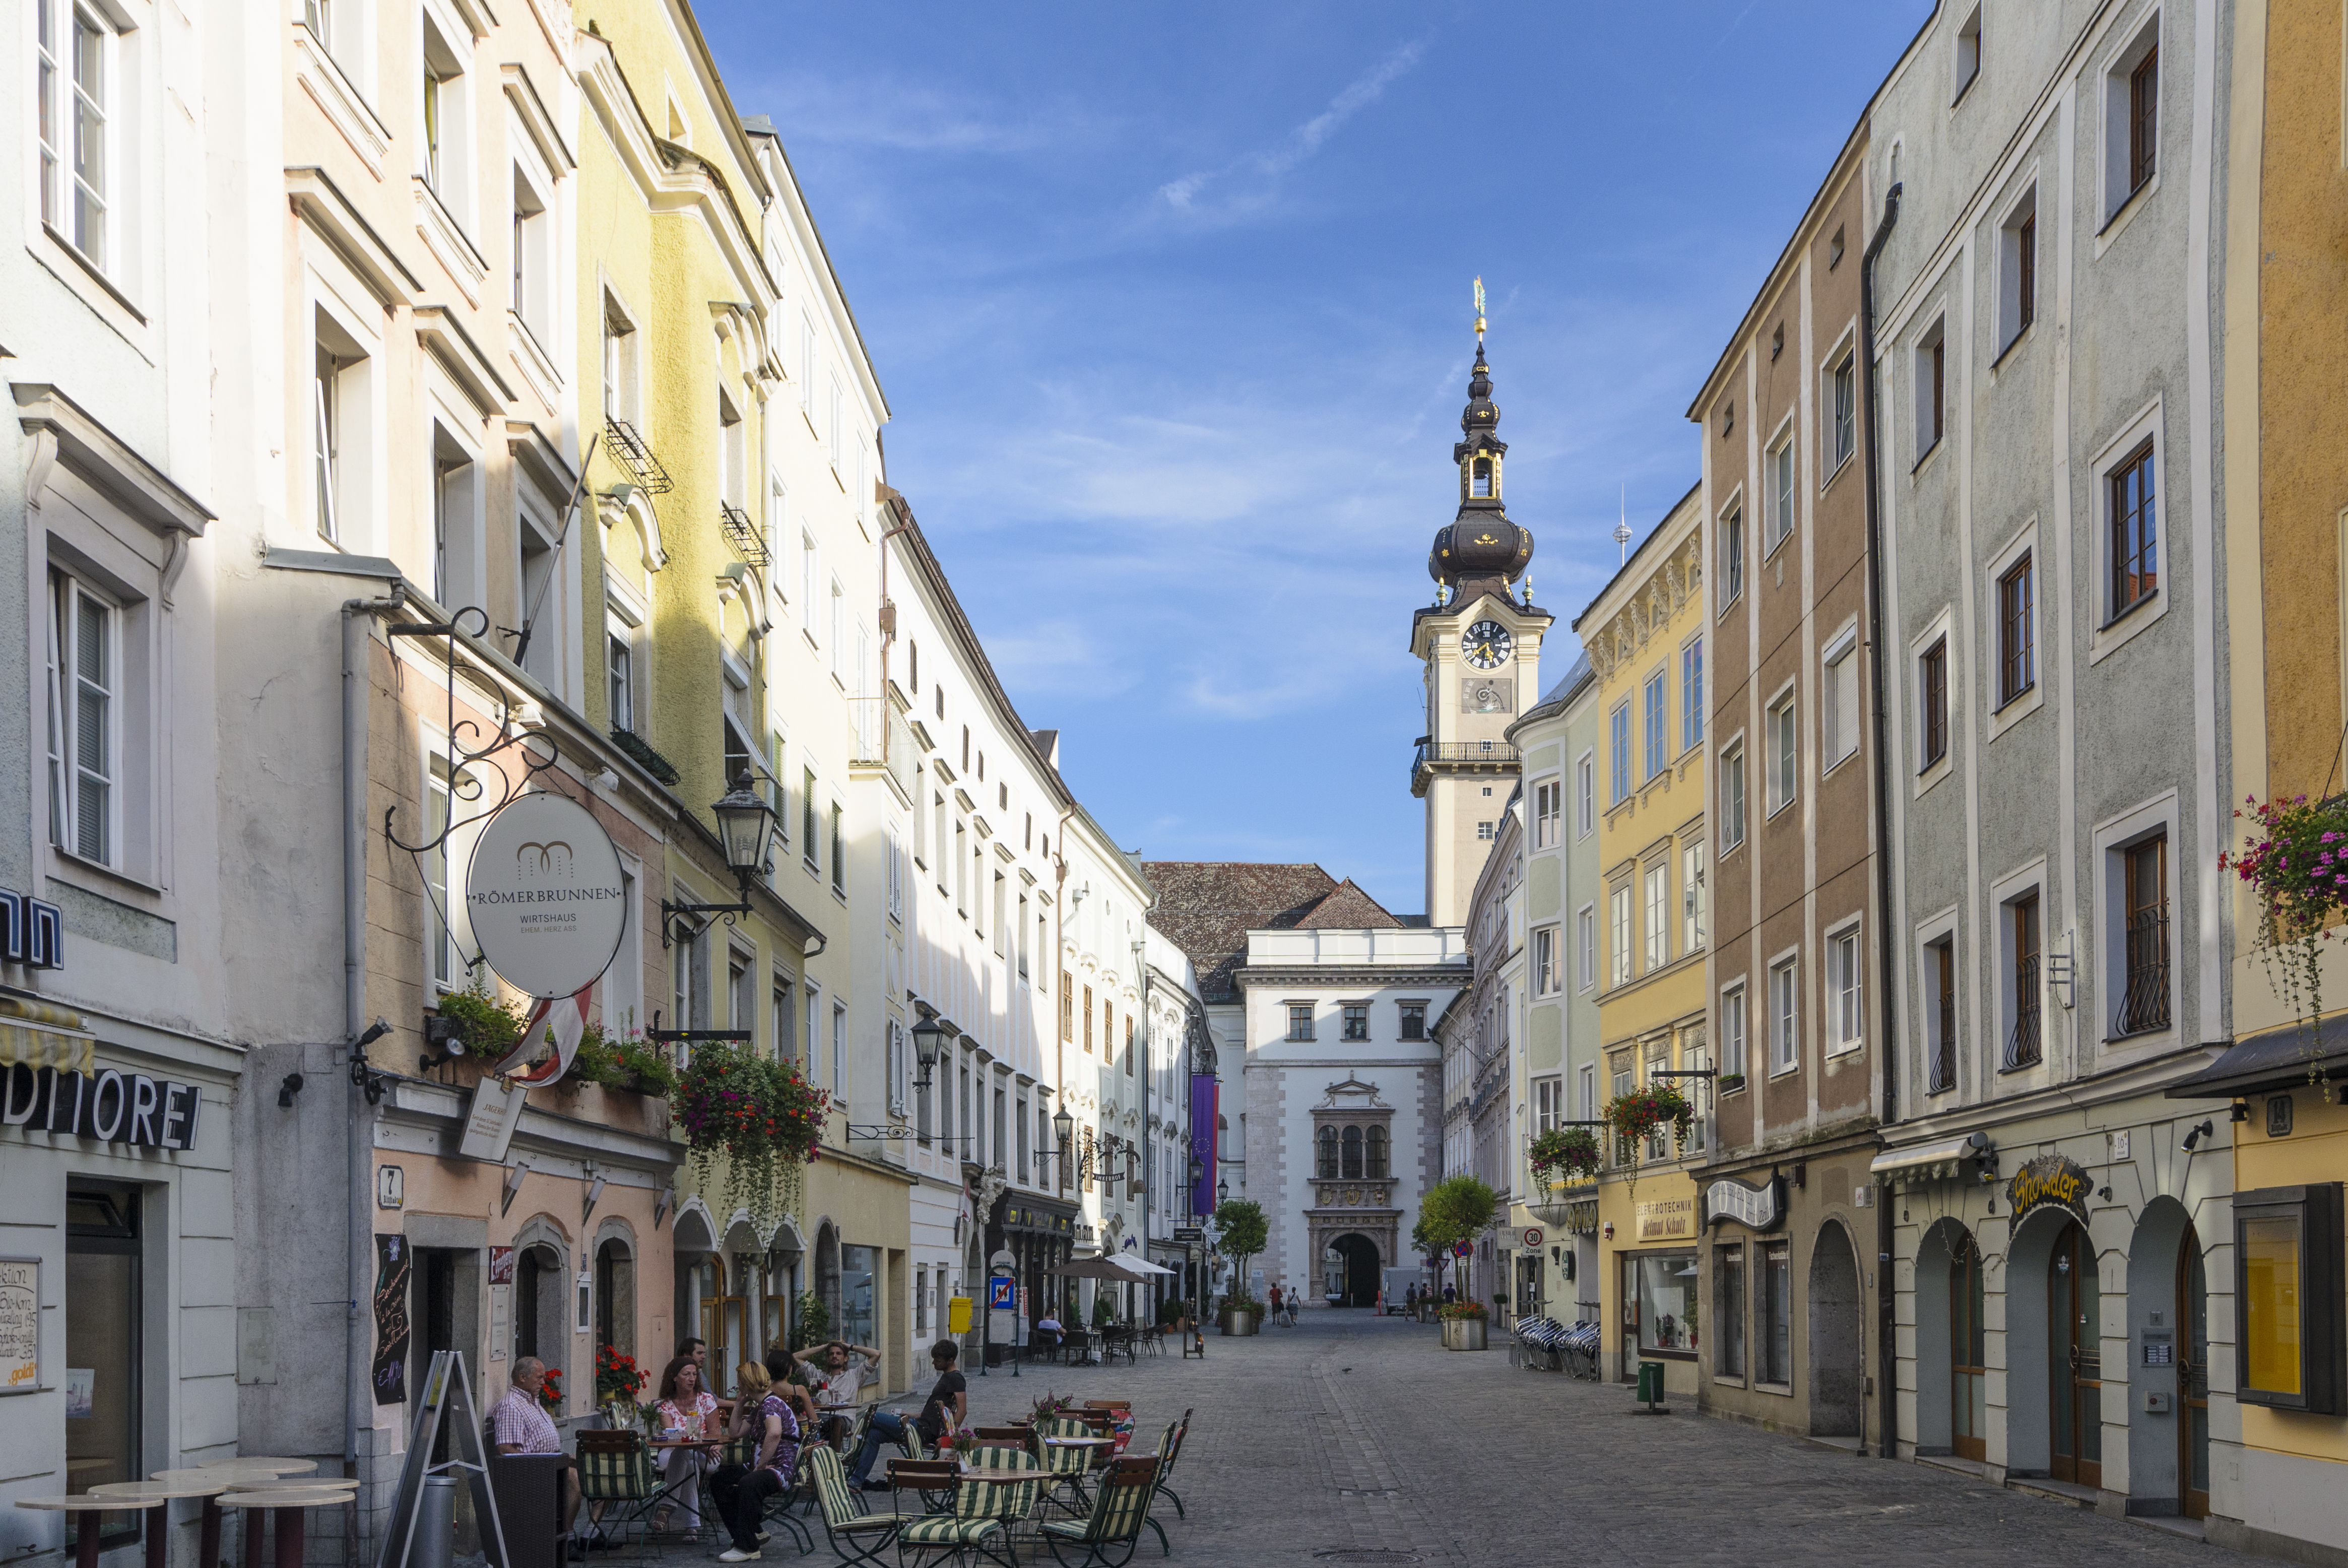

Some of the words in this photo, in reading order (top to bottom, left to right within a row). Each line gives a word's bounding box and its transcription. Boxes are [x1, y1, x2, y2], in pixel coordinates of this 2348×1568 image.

[520, 913, 576, 924] WIRTSHAUS
[2117, 1135, 2124, 1149] 16
[388, 1170, 395, 1195] 7
[2015, 1162, 2079, 1214] Showder
[1637, 1200, 1691, 1216] ELEKTROTECHNIK
[1643, 1219, 1663, 1236] Helmut
[1529, 1233, 1538, 1242] 30
